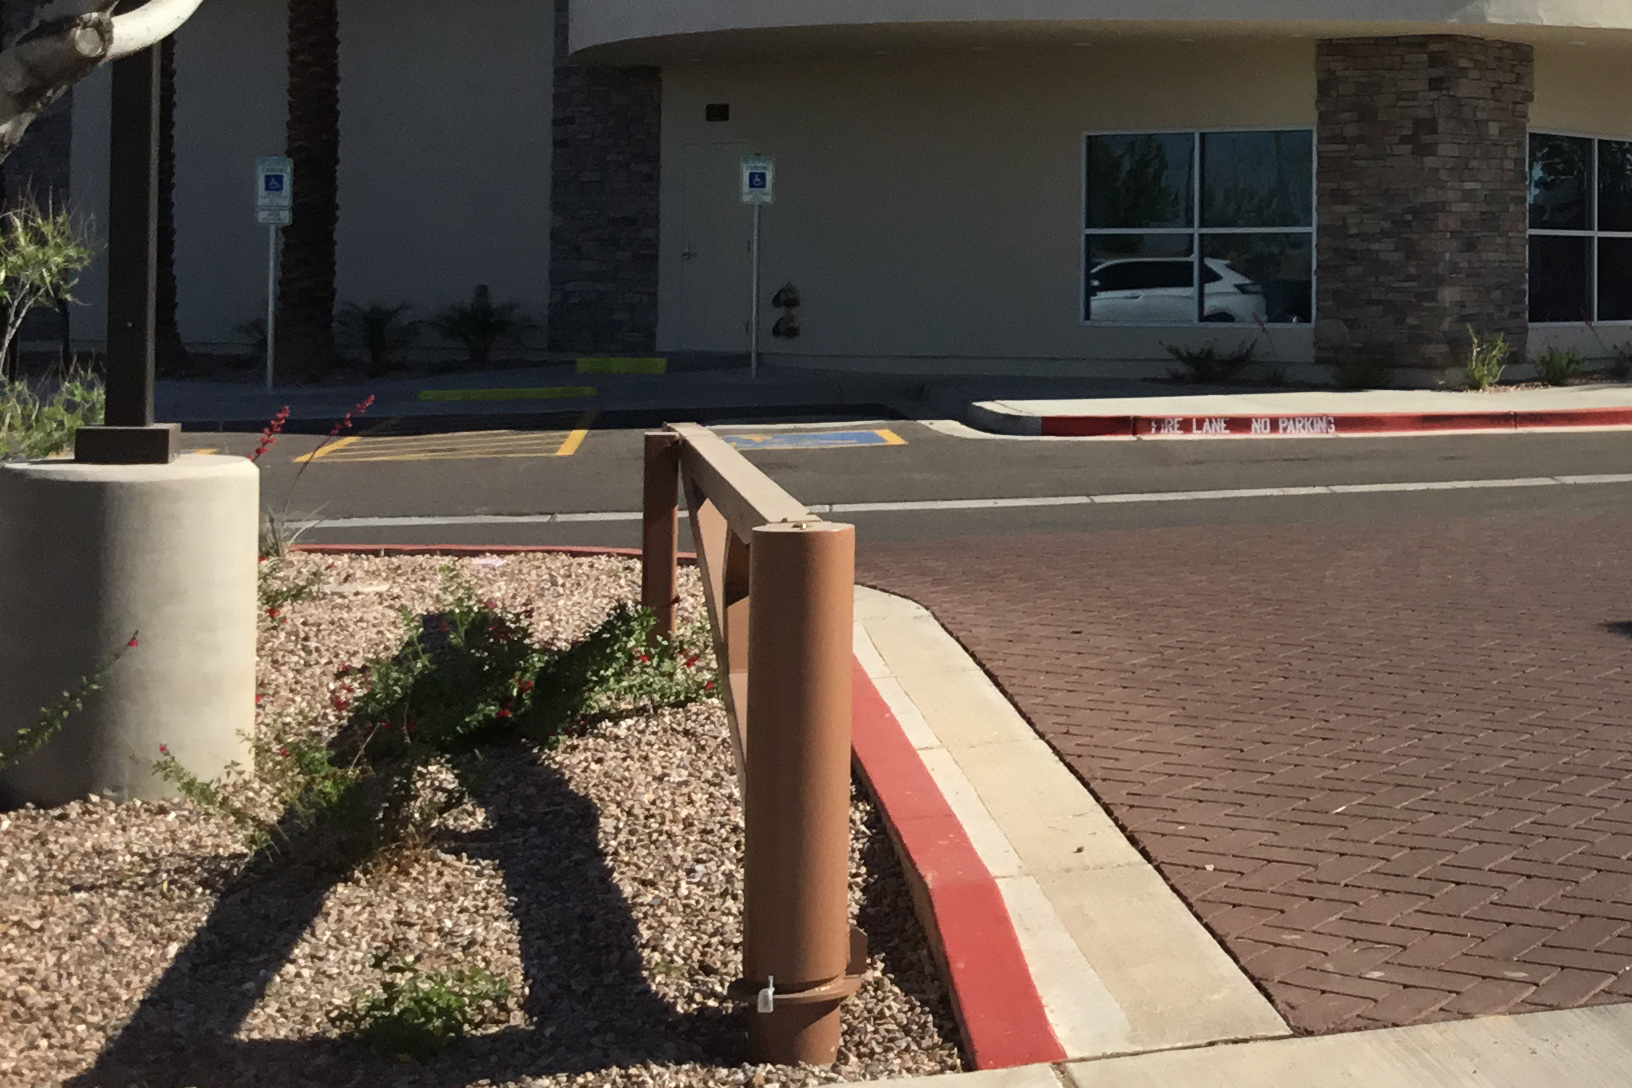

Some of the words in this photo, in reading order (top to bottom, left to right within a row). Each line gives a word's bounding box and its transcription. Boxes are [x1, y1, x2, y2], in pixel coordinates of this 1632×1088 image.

[1151, 417, 1184, 434] FIRE
[1192, 417, 1231, 434] LANE
[1251, 417, 1271, 434] NO
[1278, 416, 1336, 434] PARKING
